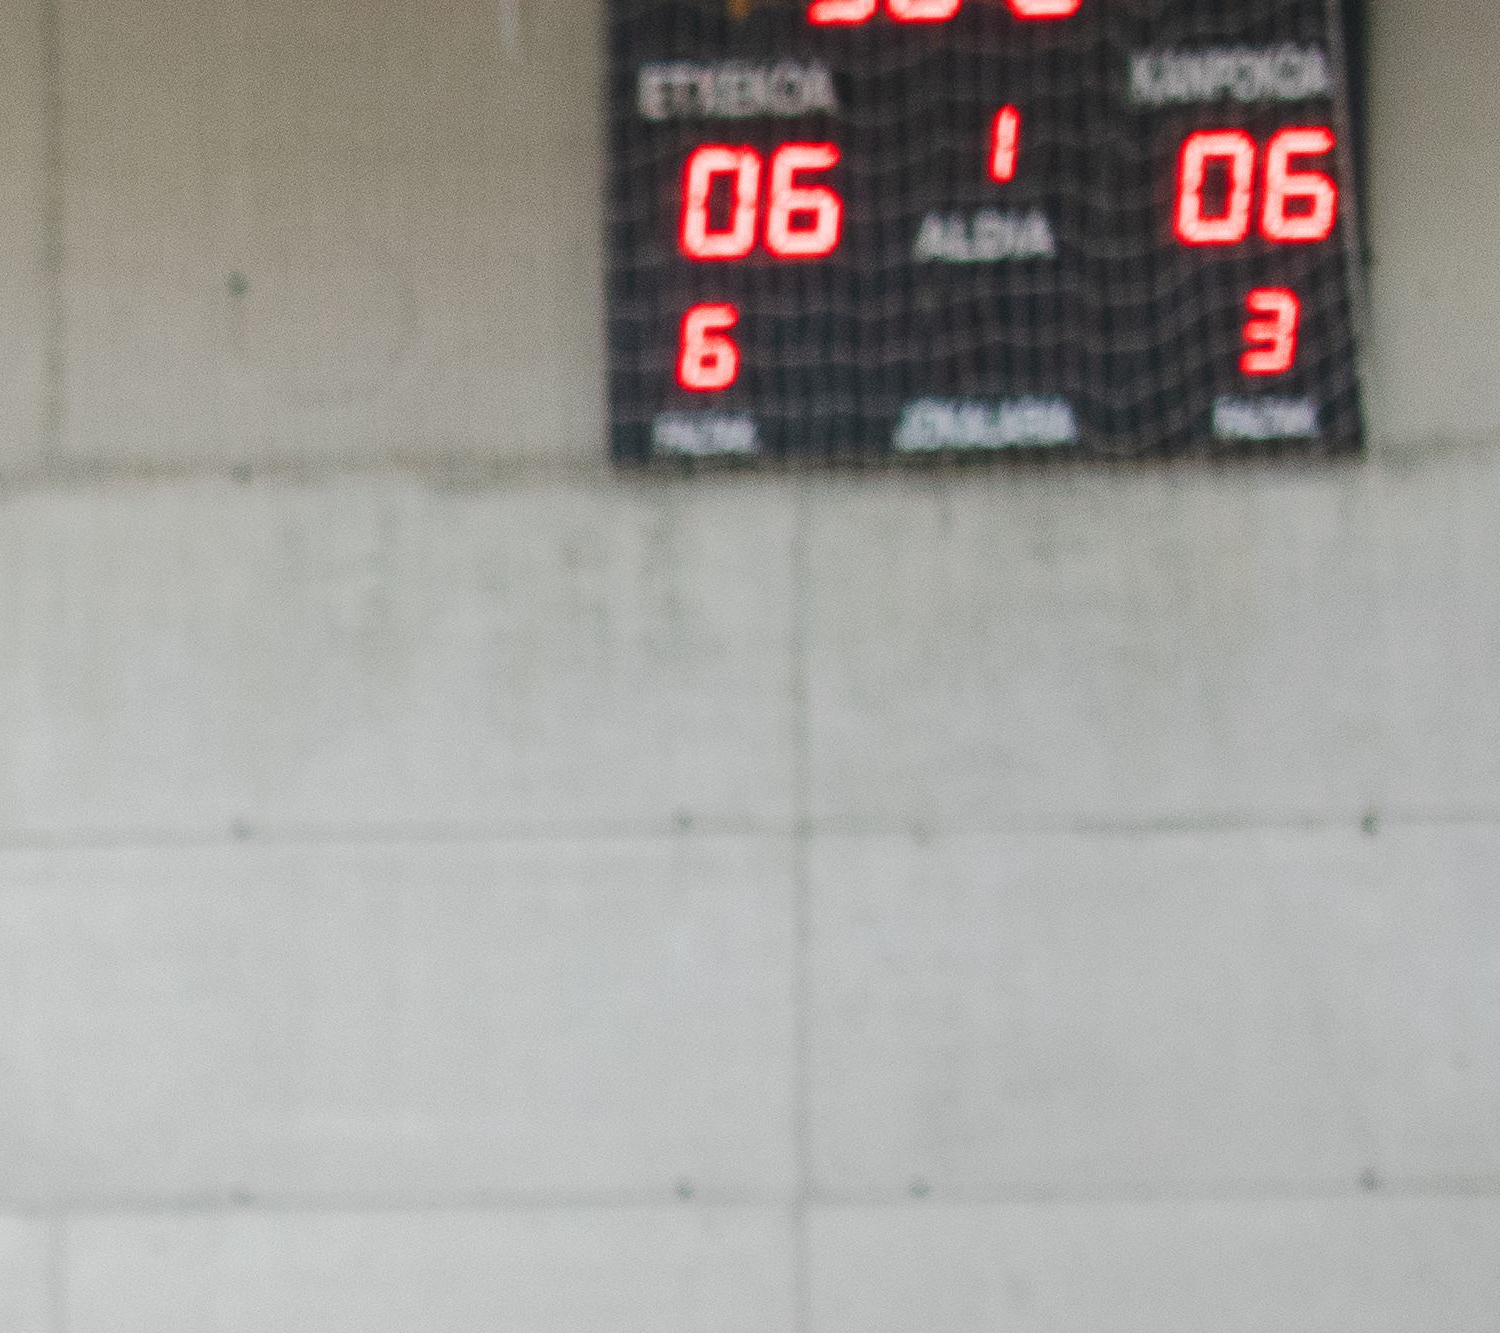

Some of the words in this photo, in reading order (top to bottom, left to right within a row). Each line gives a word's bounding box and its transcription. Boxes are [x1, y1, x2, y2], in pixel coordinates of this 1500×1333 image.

[986, 104, 1021, 183] 1
[1173, 128, 1336, 246] 06
[680, 142, 843, 260] 06
[677, 302, 740, 391] 6
[1239, 287, 1298, 374] 3
